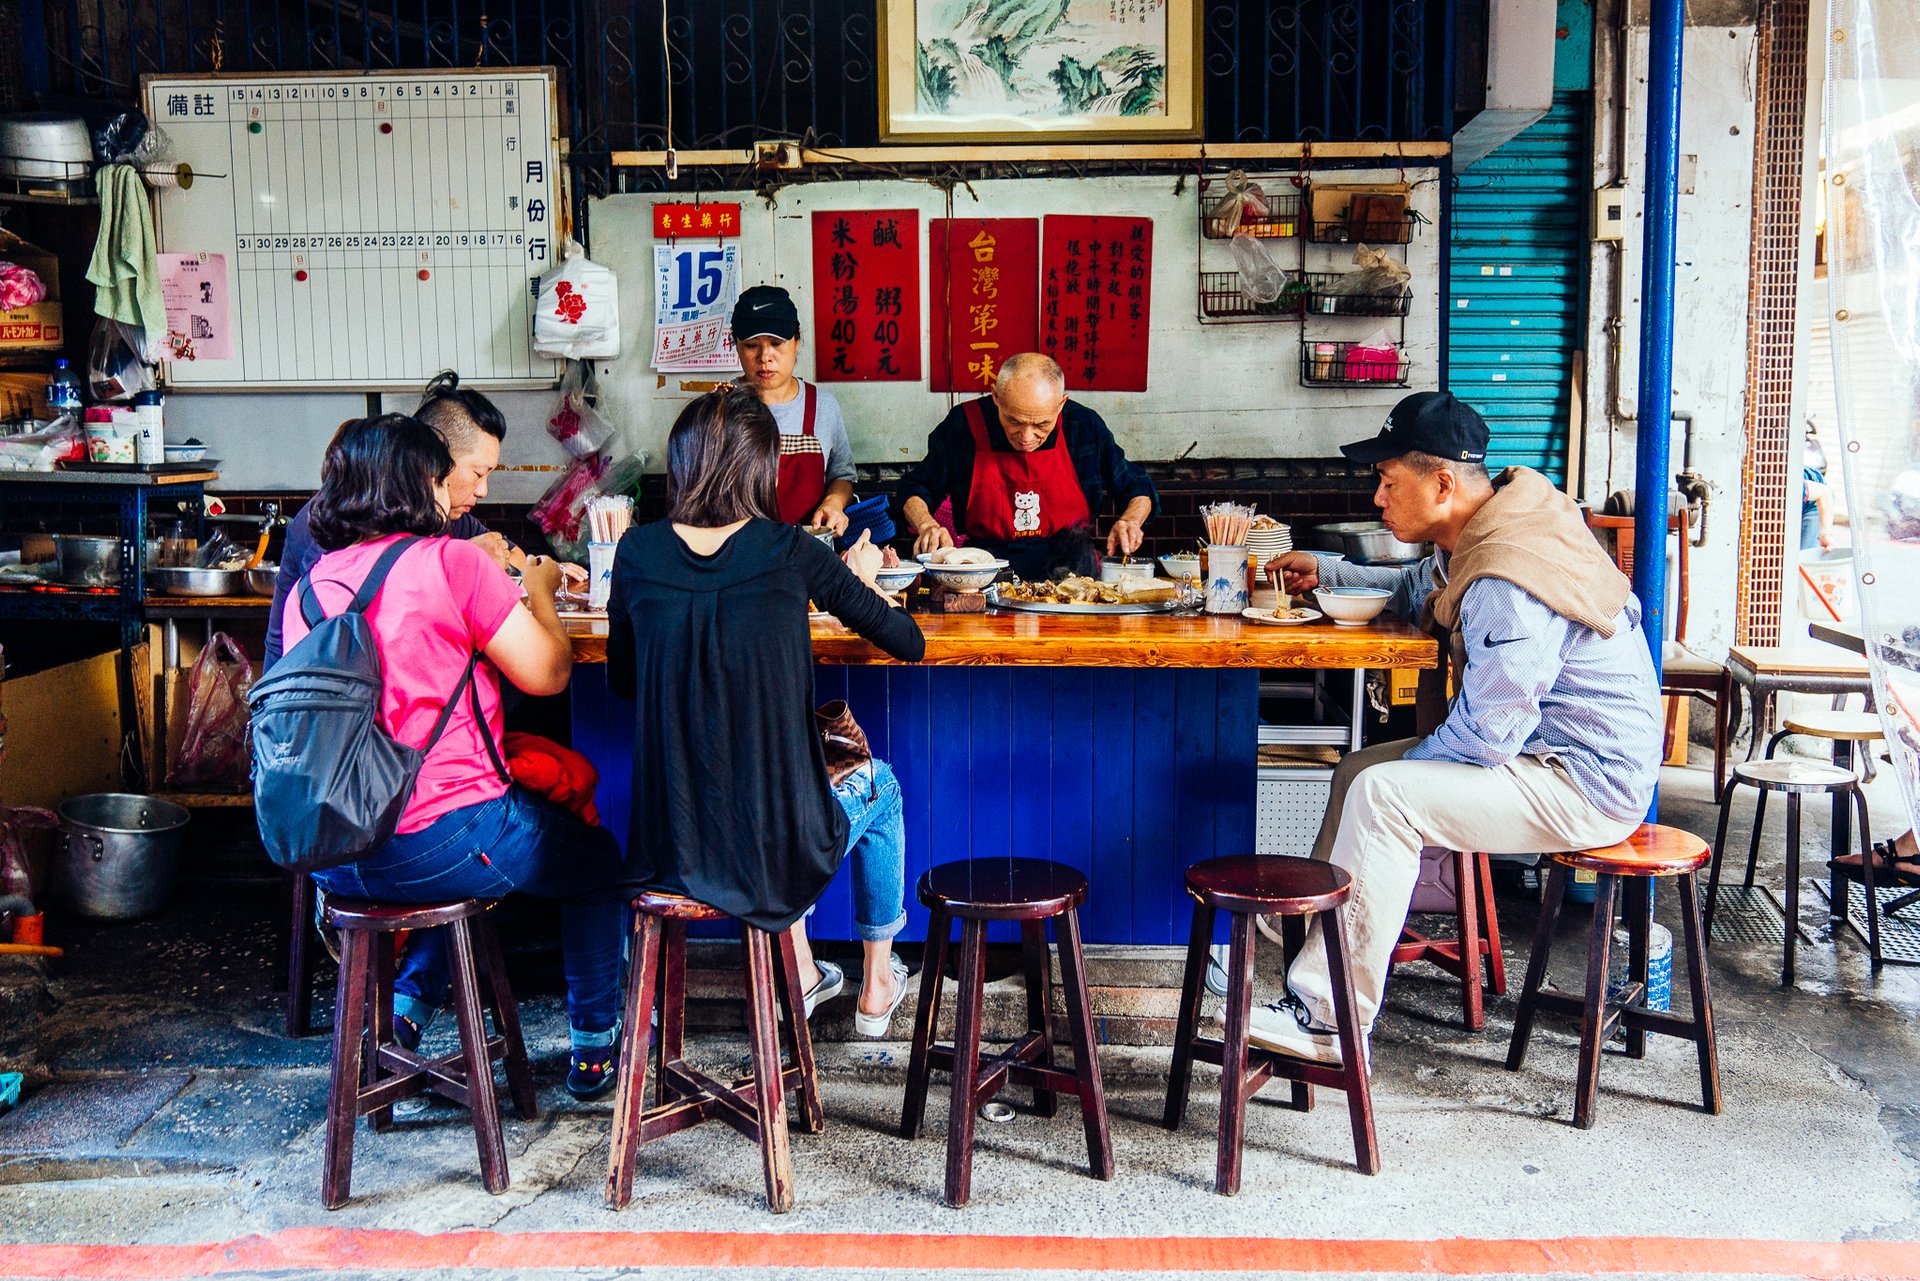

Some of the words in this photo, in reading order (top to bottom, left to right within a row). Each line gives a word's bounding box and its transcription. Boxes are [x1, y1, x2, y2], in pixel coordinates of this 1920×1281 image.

[167, 94, 214, 116] 備註
[232, 90, 245, 99] 15
[250, 89, 262, 99] 14
[268, 89, 280, 99] 13
[287, 88, 299, 98] 12
[305, 88, 315, 98] 11
[322, 88, 335, 98] 10
[342, 88, 349, 97] 9
[360, 87, 367, 97] 8
[378, 86, 385, 97] 7
[397, 86, 404, 96] 6
[415, 86, 422, 96] 5
[433, 86, 440, 96] 4
[451, 85, 458, 95] 3
[470, 85, 476, 95] 2
[489, 85, 493, 95] 1
[239, 239, 251, 248] 31
[257, 239, 270, 248] 30
[275, 238, 288, 248] 29
[293, 238, 306, 247] 28
[311, 238, 324, 247] 27
[328, 237, 342, 247] 26
[346, 237, 359, 246] 25
[364, 237, 377, 246] 24
[382, 236, 396, 246] 23
[400, 236, 413, 246] 22
[418, 236, 430, 246] 21
[436, 236, 450, 246] 20
[456, 236, 468, 245] 19
[474, 236, 486, 245] 18
[492, 235, 504, 245] 17
[510, 235, 522, 244] 16
[1065, 240, 1083, 295] 很抱歉
[672, 250, 724, 309] 15
[831, 218, 858, 374] 米粉湯40元
[968, 230, 999, 386] 台灣第一味
[681, 310, 707, 321] 星期一
[1046, 266, 1060, 359] 大稻埕米粉
[1083, 240, 1101, 384] 中午時間暫停外帶
